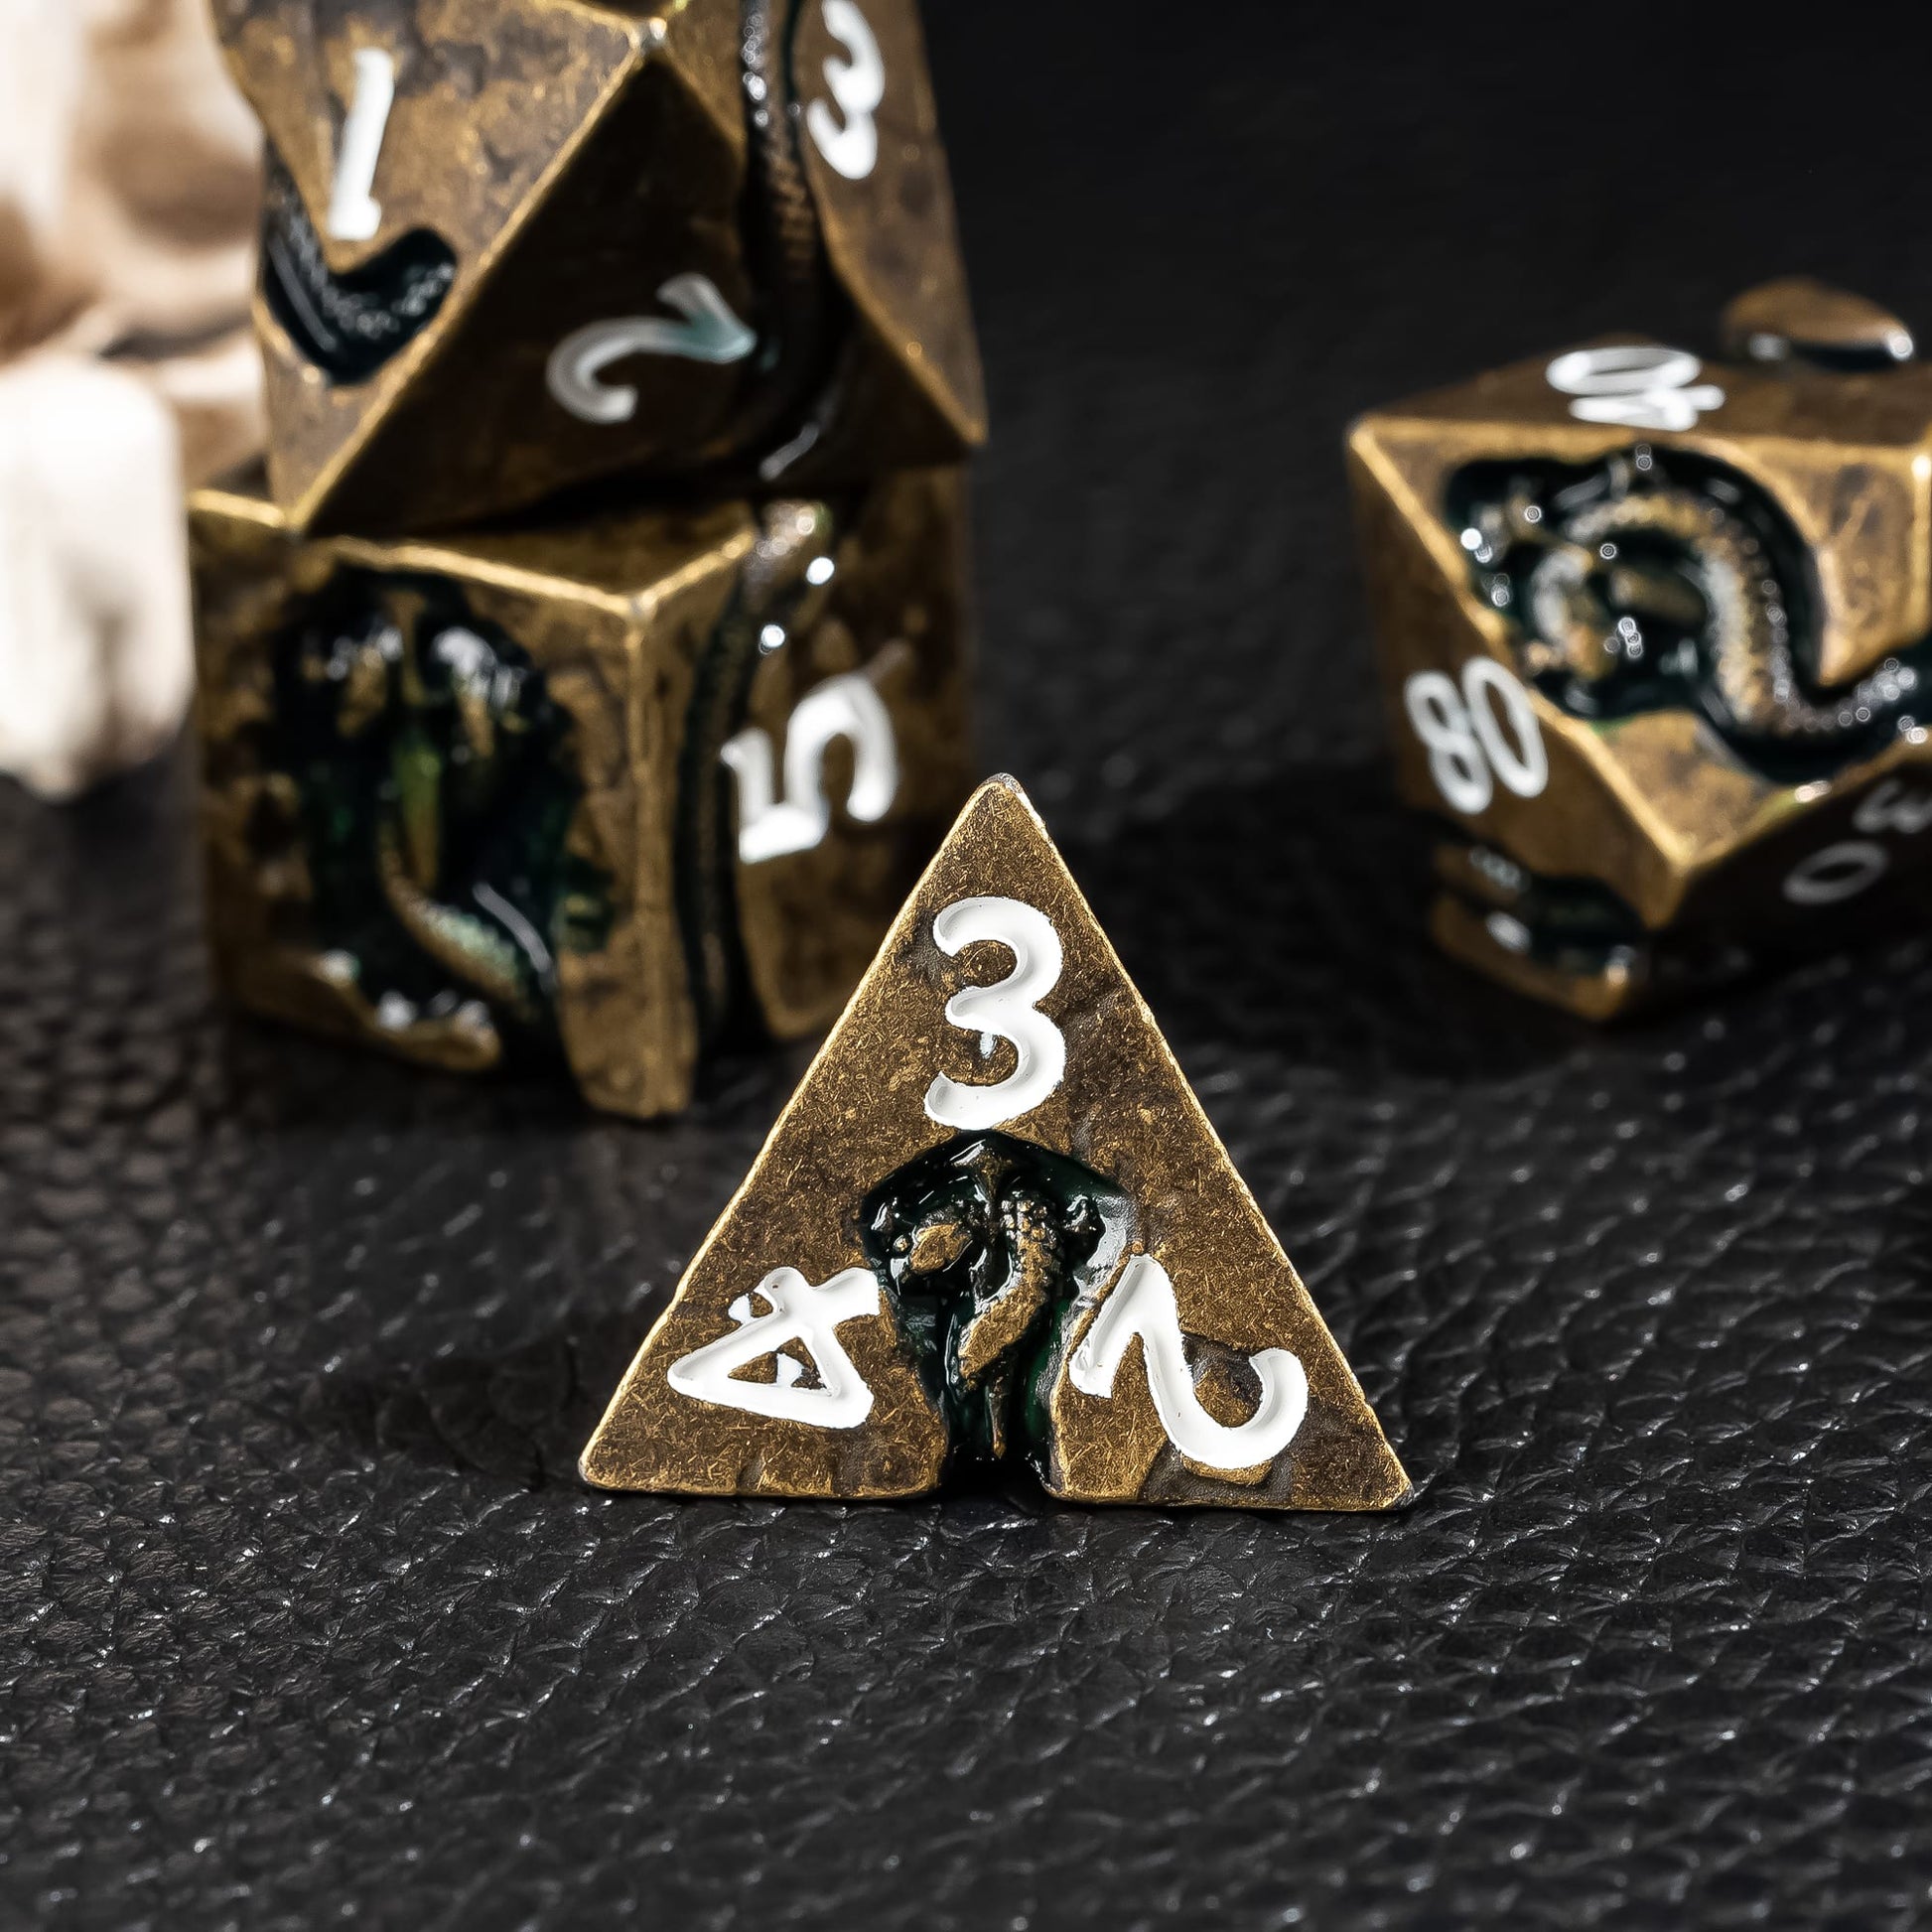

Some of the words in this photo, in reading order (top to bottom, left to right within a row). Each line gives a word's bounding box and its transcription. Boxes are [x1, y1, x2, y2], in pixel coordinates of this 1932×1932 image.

[329, 48, 396, 241] 1
[806, 0, 886, 180] 3
[546, 272, 758, 424] 2
[721, 671, 899, 863] 5
[1405, 655, 1550, 815] 80
[923, 896, 1066, 1130] 3
[666, 1266, 881, 1429] 4
[1069, 1253, 1309, 1468] 2
